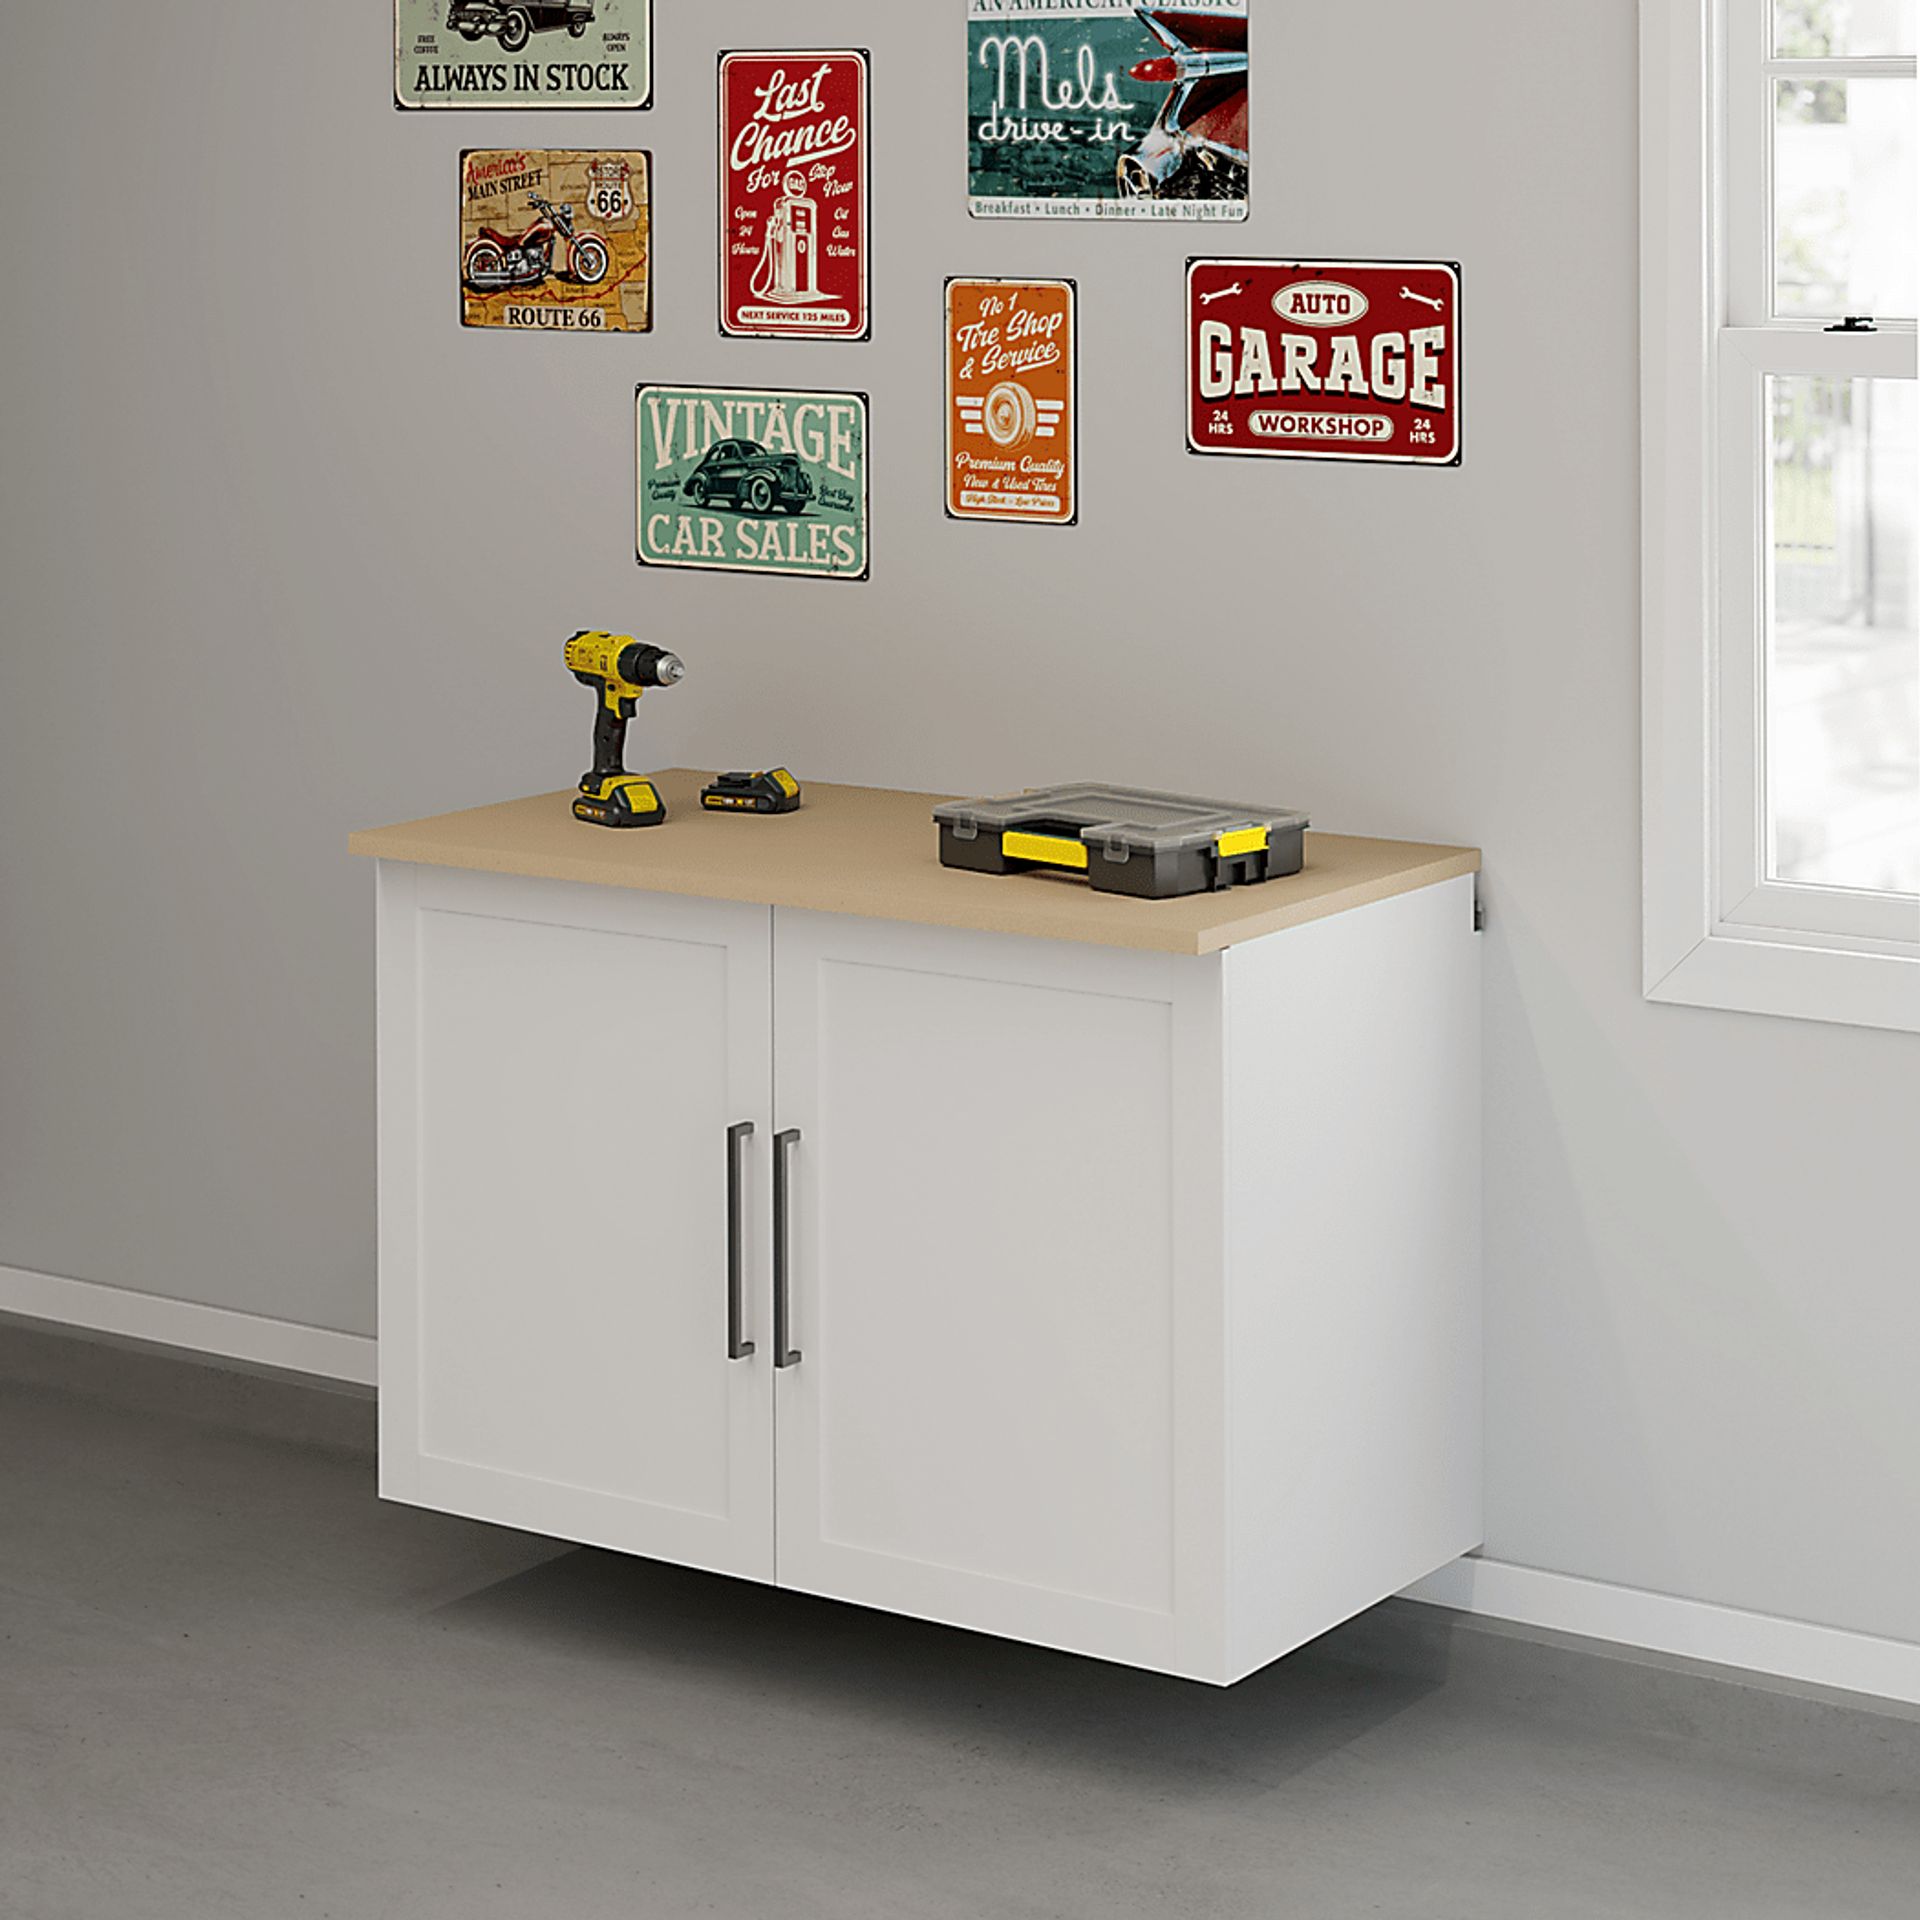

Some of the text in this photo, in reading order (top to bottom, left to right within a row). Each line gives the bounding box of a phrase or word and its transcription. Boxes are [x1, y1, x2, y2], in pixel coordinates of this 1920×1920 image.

[414, 63, 629, 92] ALWAYS IN STOCK
[979, 35, 1135, 110] Mels
[753, 63, 832, 122] Last
[978, 100, 1136, 141] drive-in
[730, 115, 857, 171] Chance
[467, 168, 542, 201] MAIN STREET
[746, 165, 780, 193] For
[597, 190, 622, 213] 66
[734, 205, 757, 220] Open
[834, 207, 849, 220] Oil
[975, 201, 1244, 219] Breakfast Lunch Dinner Late Night Fun
[739, 225, 753, 237] 24
[741, 310, 846, 322] NEXT SERVICE 125 MILES
[979, 291, 1018, 318] No 1
[1289, 293, 1351, 314] AUTO
[508, 307, 600, 327] ROUTE 66
[956, 309, 1063, 352] Tire Shop
[959, 340, 1060, 379] & Service
[1200, 320, 1446, 410] GARAGE
[1208, 422, 1234, 435] HRS
[1212, 410, 1229, 422] 24
[1258, 415, 1384, 437] WORKSHOP
[1413, 418, 1431, 431] 24
[647, 397, 856, 480] VINTAGE
[1409, 431, 1436, 444] HRS
[956, 451, 1065, 480] Premium Quality
[963, 473, 989, 487] New
[1002, 476, 1031, 490] Used
[647, 514, 856, 567] CAR SALES
